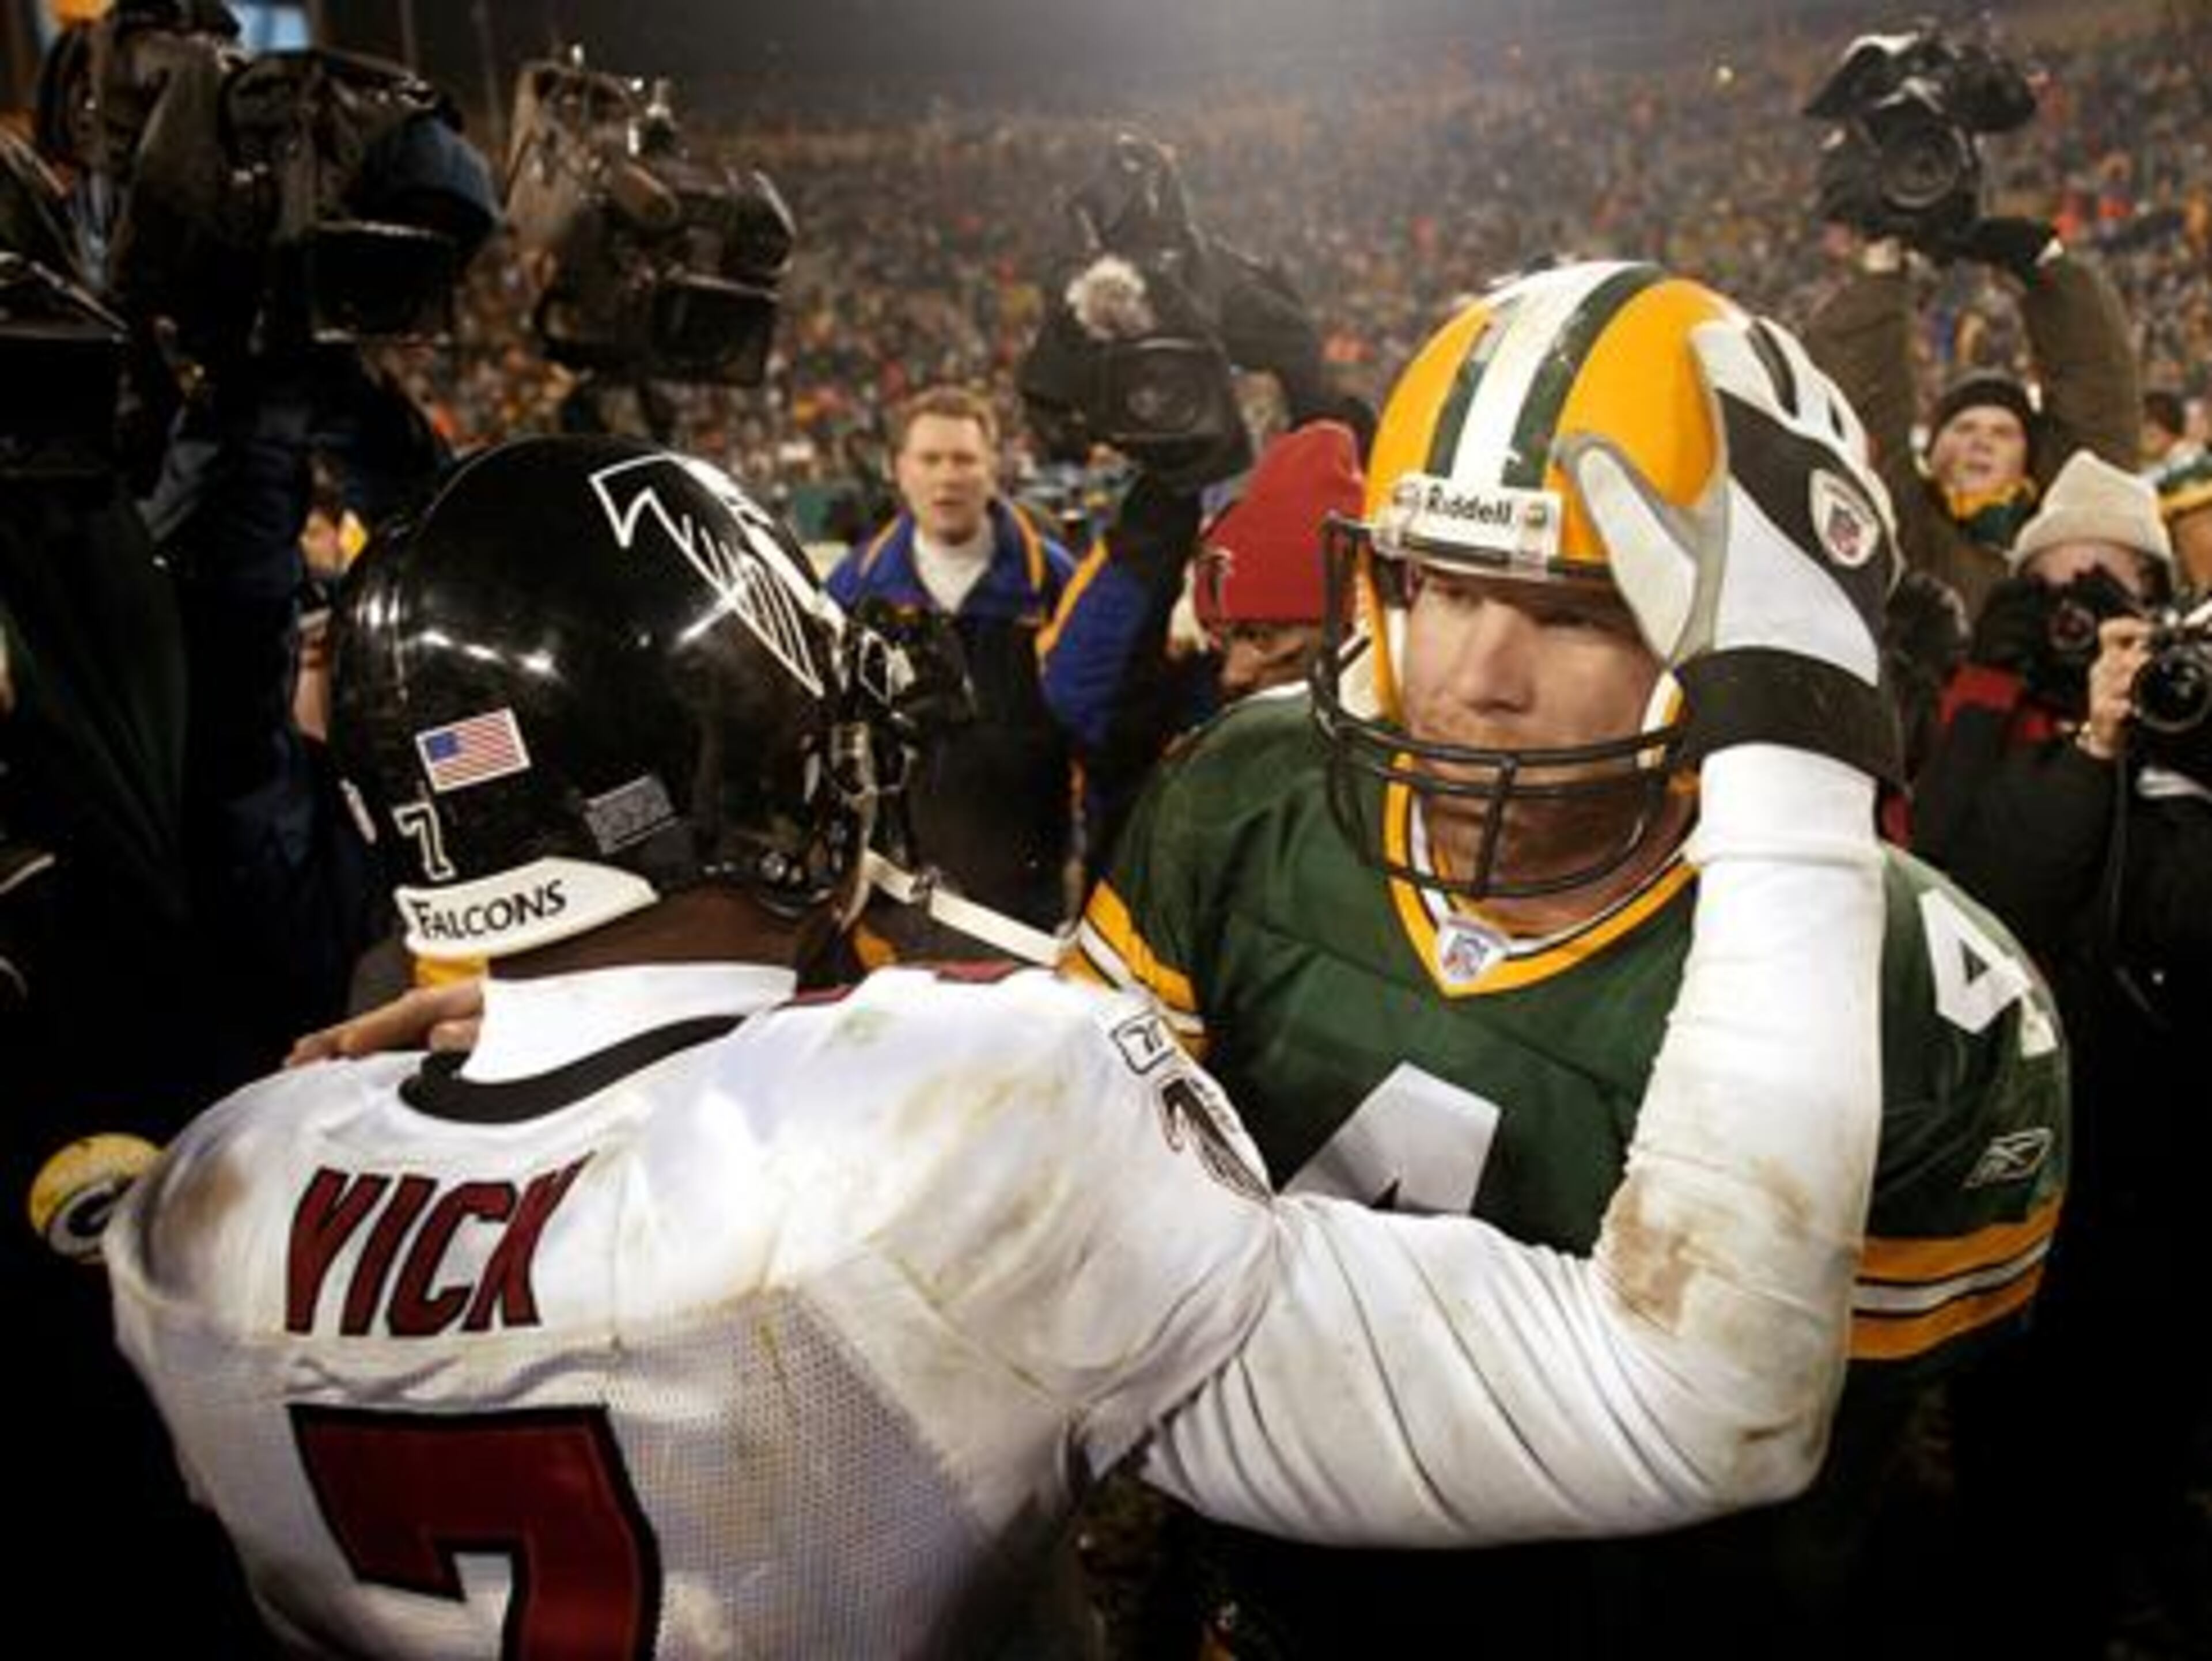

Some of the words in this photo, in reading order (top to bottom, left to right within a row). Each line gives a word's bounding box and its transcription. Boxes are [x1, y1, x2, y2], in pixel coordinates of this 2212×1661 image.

[1425, 484, 1513, 525] Riddell
[393, 800, 456, 881] 7
[408, 878, 567, 941] FALCONS
[1918, 889, 2058, 1059] 4
[284, 1152, 597, 1337] VICK
[286, 1403, 663, 1661] 7
